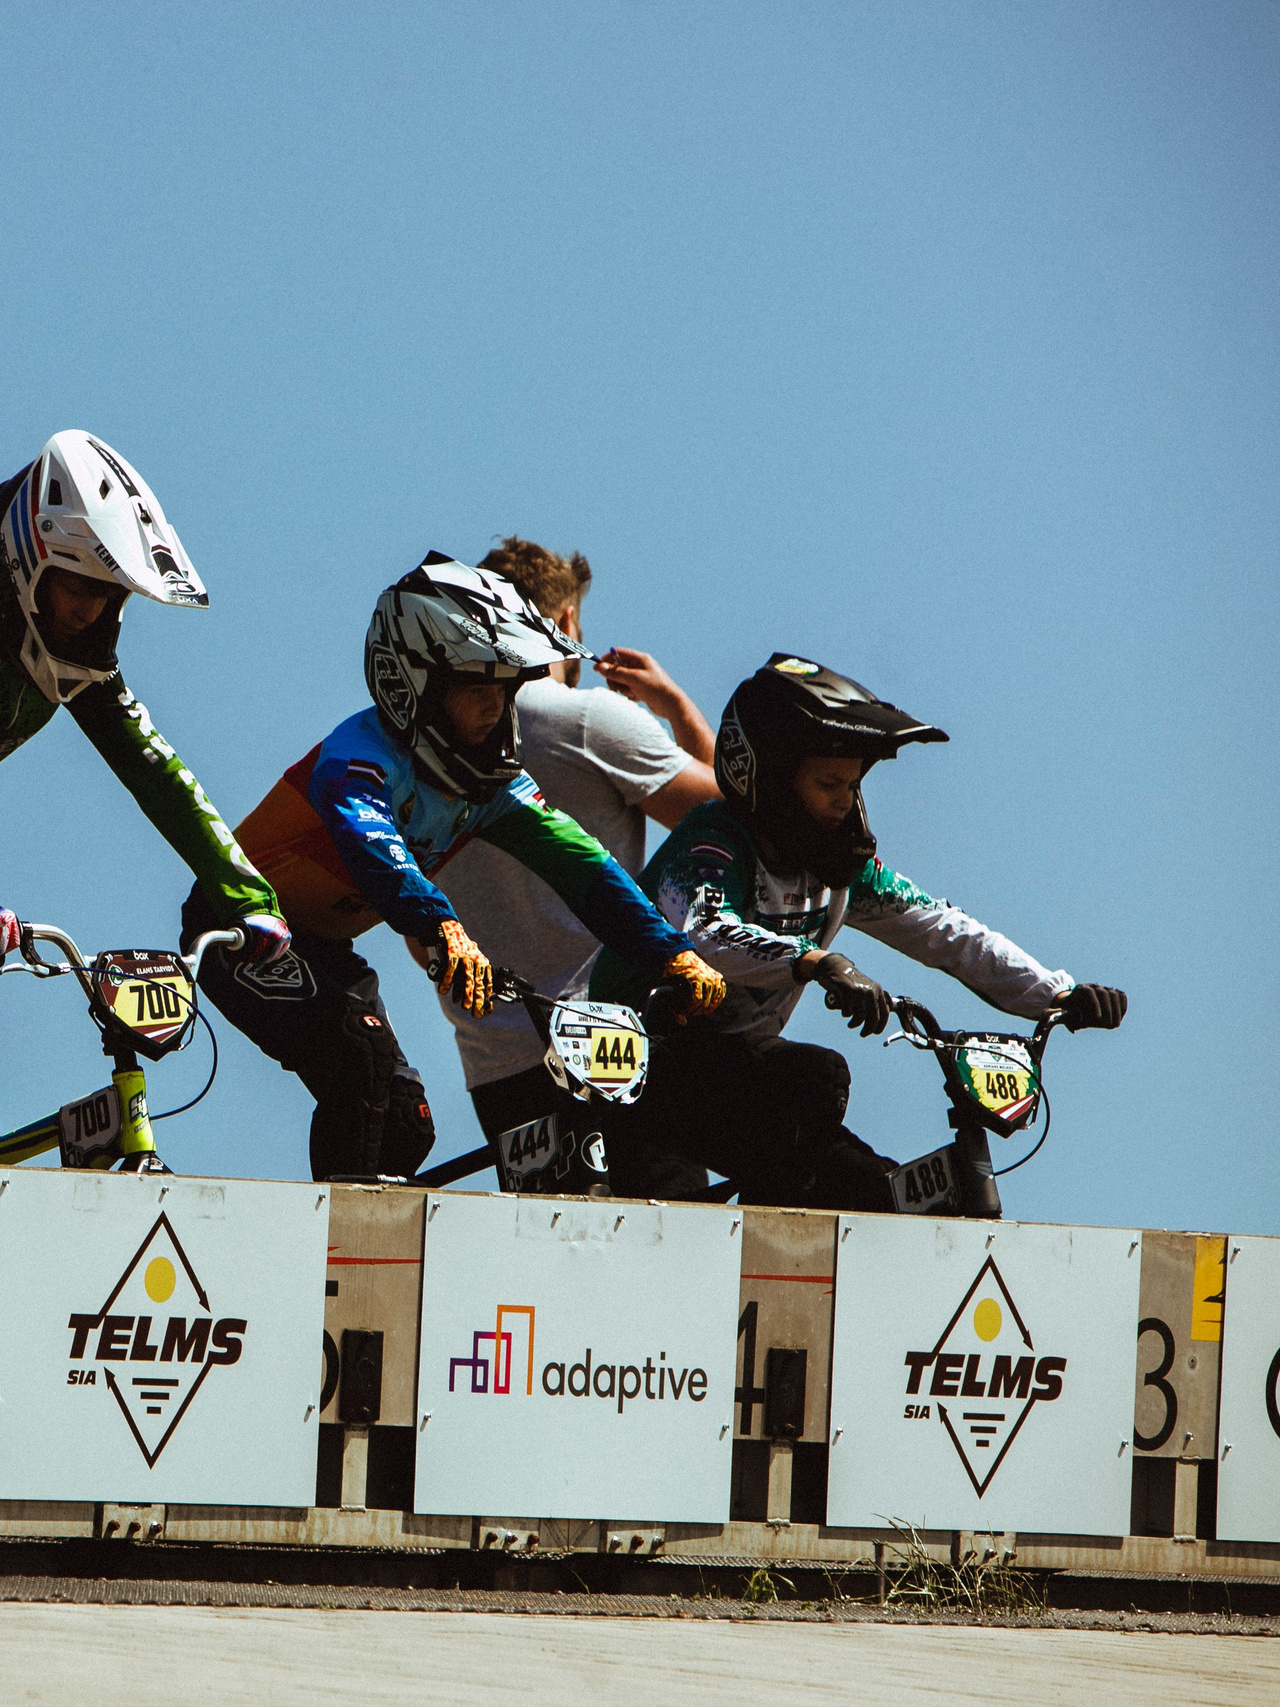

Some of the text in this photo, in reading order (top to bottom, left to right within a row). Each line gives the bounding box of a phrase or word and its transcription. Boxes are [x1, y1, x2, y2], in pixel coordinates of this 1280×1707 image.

[94, 543, 121, 573] KENNY
[133, 950, 149, 960] box
[129, 982, 181, 1021] 700
[596, 1036, 636, 1070] 444
[985, 1033, 1000, 1043] box
[985, 1072, 1020, 1101] 488
[69, 1097, 111, 1143] 700
[509, 1116, 550, 1166] 444
[905, 1156, 948, 1204] 488
[67, 1313, 248, 1365] TELMS
[67, 1369, 97, 1386] SIA
[541, 1348, 708, 1414] adaptive
[904, 1351, 1068, 1400] TELMS
[1133, 1317, 1178, 1451] 3
[904, 1404, 931, 1419] SIA
